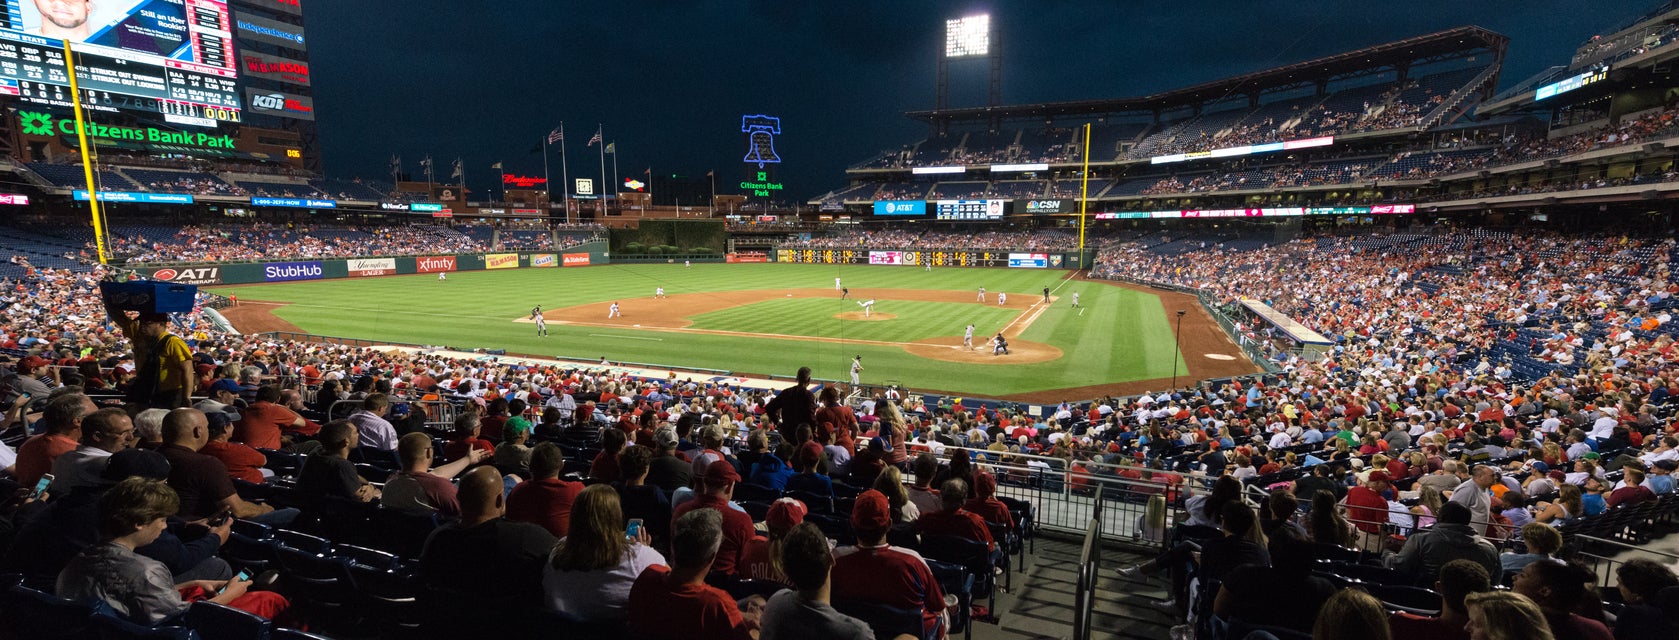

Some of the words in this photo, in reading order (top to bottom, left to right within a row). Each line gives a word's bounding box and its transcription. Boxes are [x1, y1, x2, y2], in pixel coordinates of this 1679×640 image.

[140, 10, 155, 18] Still
[168, 16, 185, 24] Uber
[158, 21, 186, 31] Rookie?
[237, 20, 294, 40] Independence
[90, 67, 117, 77] STRUCK
[92, 74, 121, 84] STRUCK
[137, 81, 165, 90] LOOKING
[206, 108, 214, 118] 0
[218, 110, 226, 120] 0
[230, 112, 237, 121] 1
[58, 119, 144, 140] Citizens
[148, 128, 194, 145] Bank
[198, 133, 235, 149] Park
[354, 260, 390, 269] Yuengling
[420, 258, 453, 271] xfinity
[535, 257, 552, 265] Gulf
[176, 268, 218, 280] ATI
[266, 264, 322, 278] StubHub
